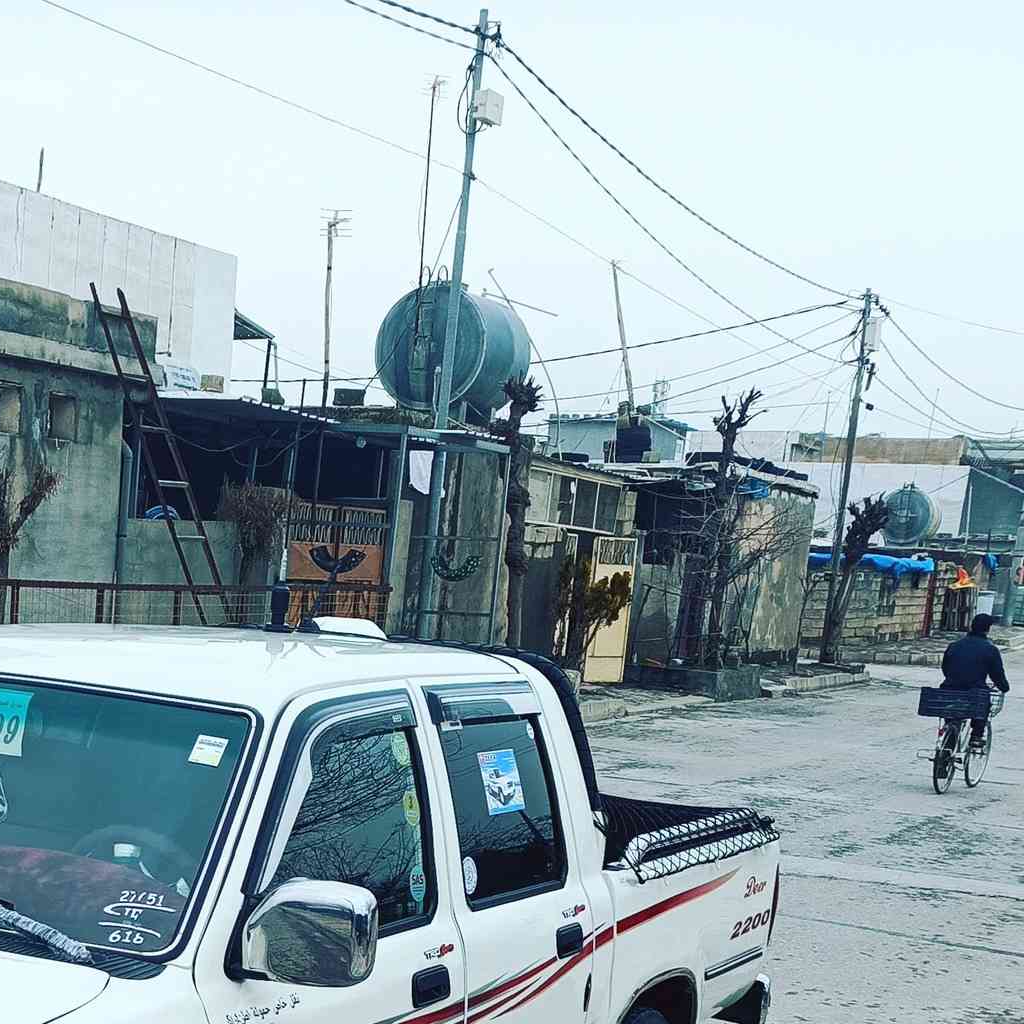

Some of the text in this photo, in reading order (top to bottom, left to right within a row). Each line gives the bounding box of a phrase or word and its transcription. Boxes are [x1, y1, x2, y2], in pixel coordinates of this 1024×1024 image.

[411, 873, 424, 885] SAS
[730, 909, 770, 940] 2200
[108, 929, 144, 944] 616
